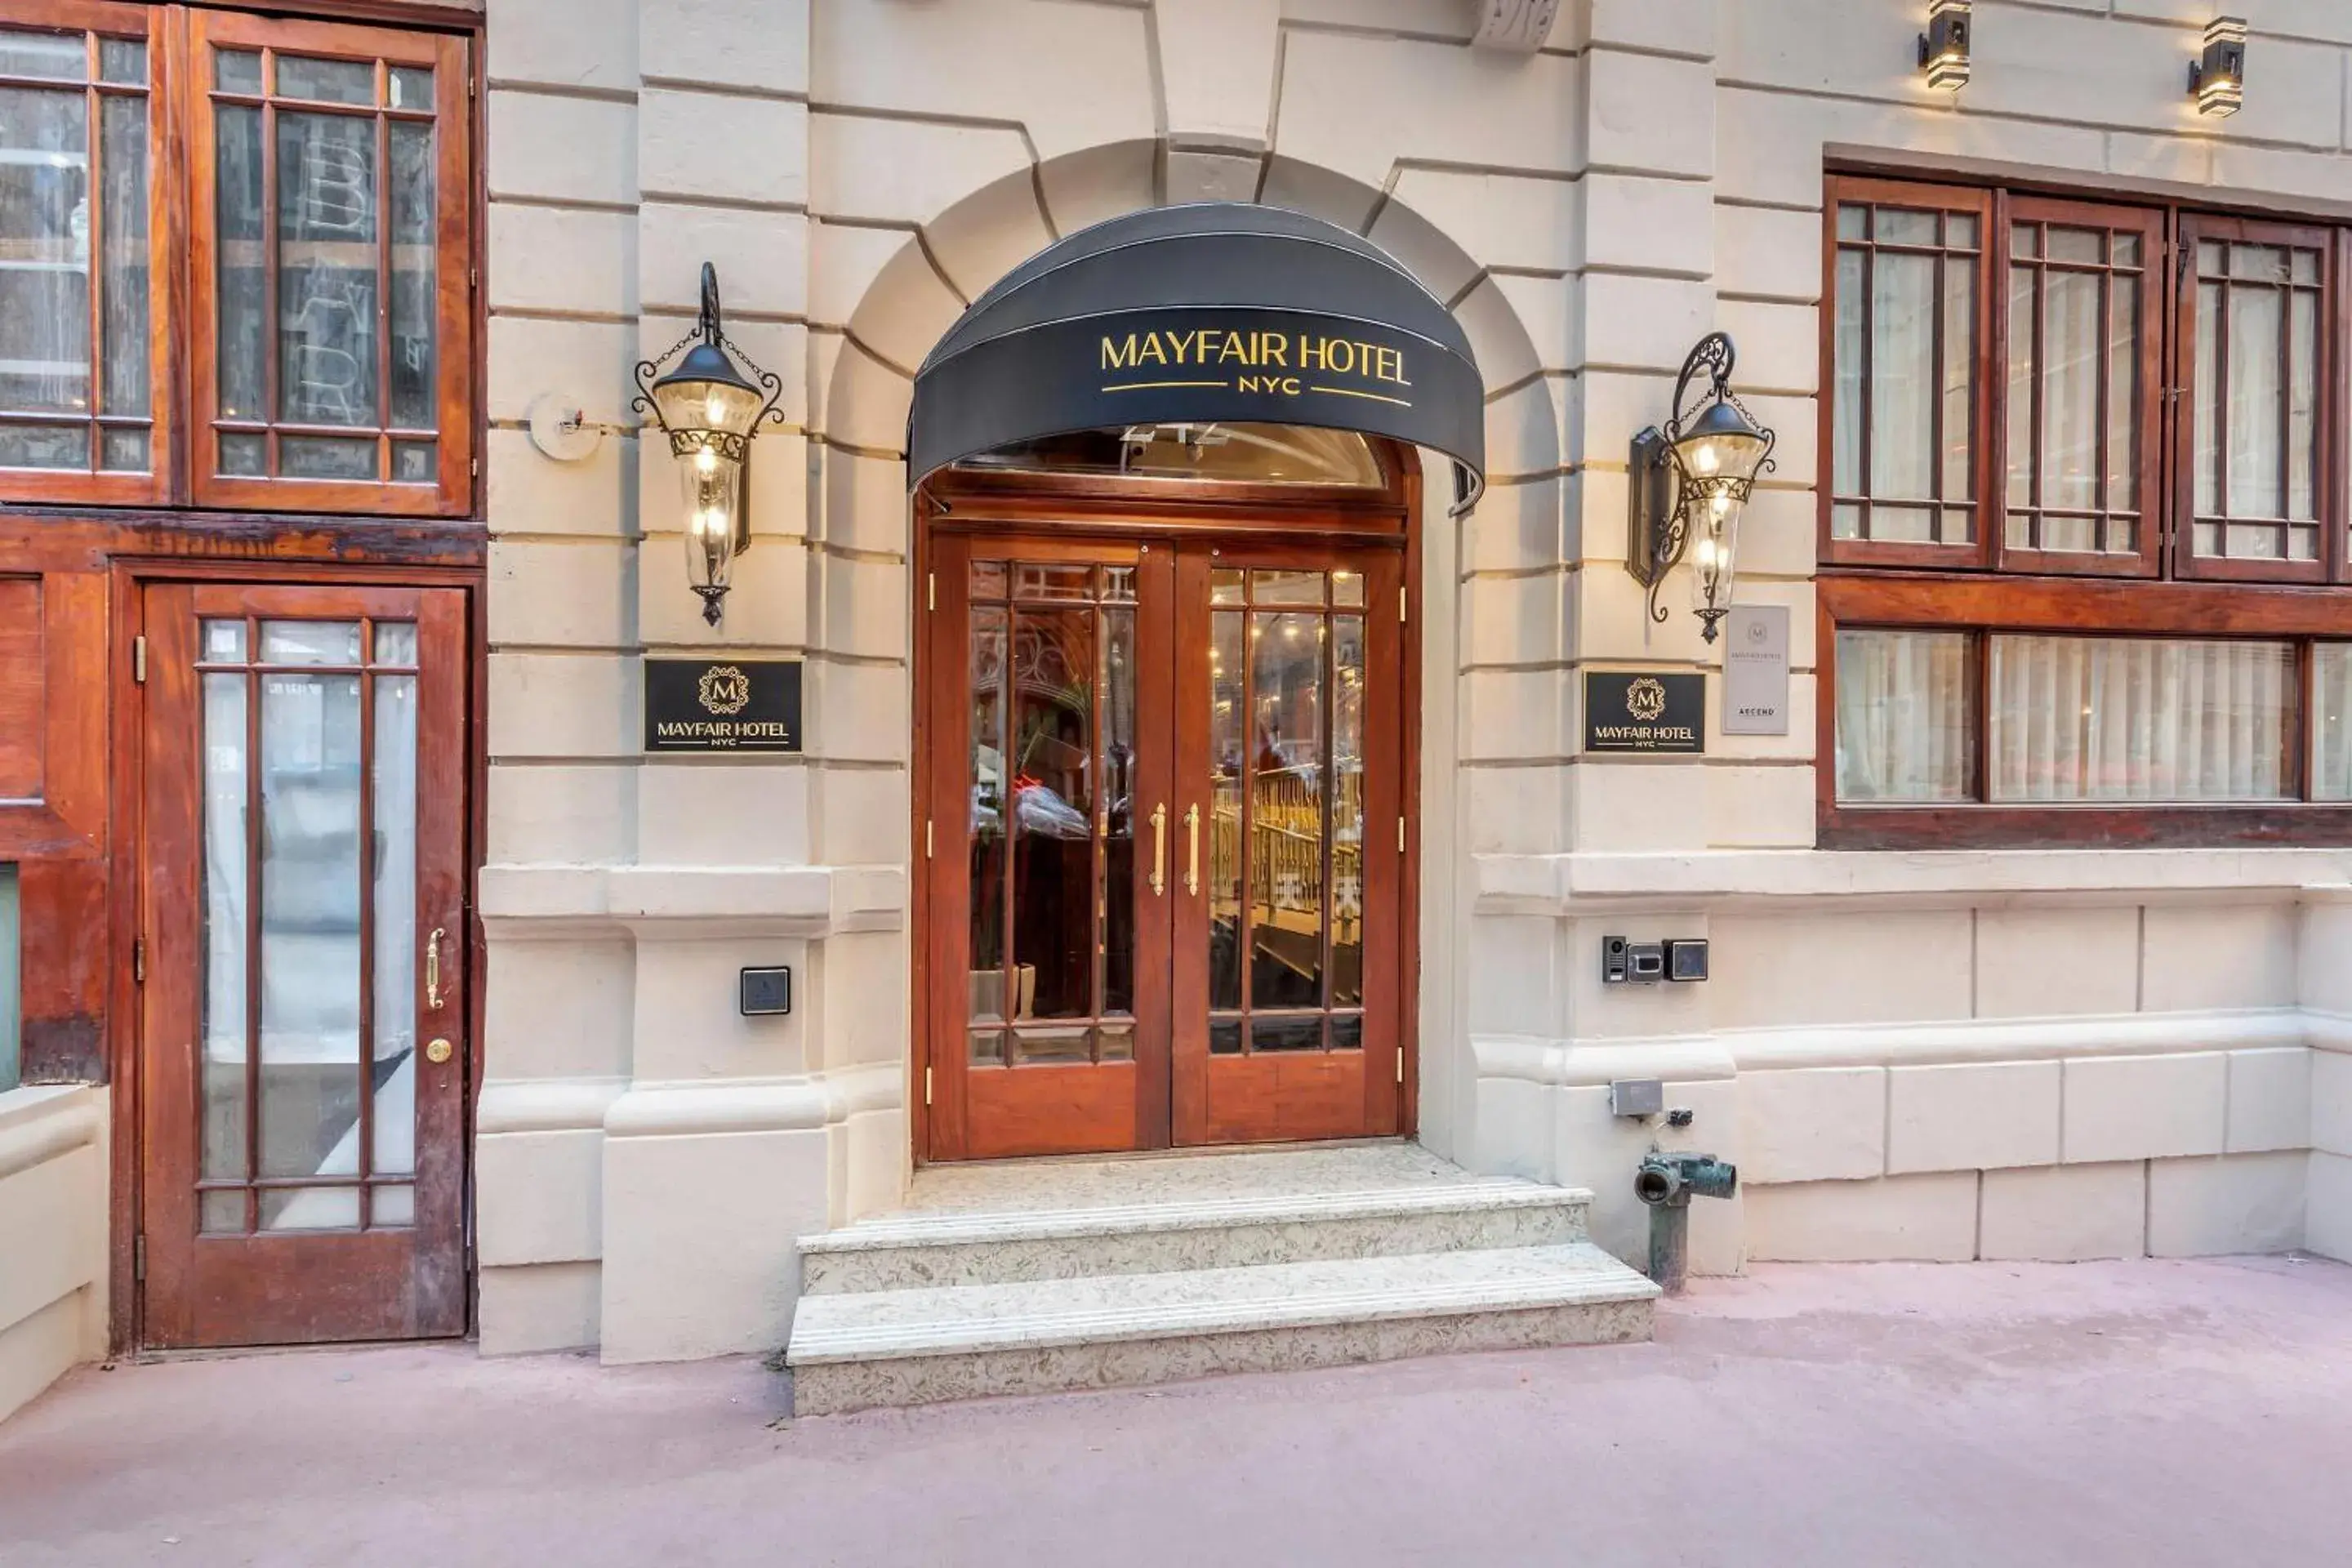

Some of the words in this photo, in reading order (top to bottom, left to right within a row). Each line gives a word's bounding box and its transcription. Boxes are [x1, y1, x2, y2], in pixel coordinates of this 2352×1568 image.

[1101, 331, 1288, 370] MAYFAIR
[1300, 334, 1412, 385] HOTEL
[1239, 376, 1300, 395] NYC
[712, 679, 737, 699] M
[1637, 690, 1656, 707] M
[1738, 707, 1775, 716] ASCEND
[658, 722, 732, 737] MAYFAIR
[735, 722, 790, 737] HOTEL
[1595, 726, 1651, 739] MAYFAIR
[1653, 726, 1695, 740] HOTEL
[711, 737, 737, 746] NYC
[1634, 739, 1655, 748] NYC
